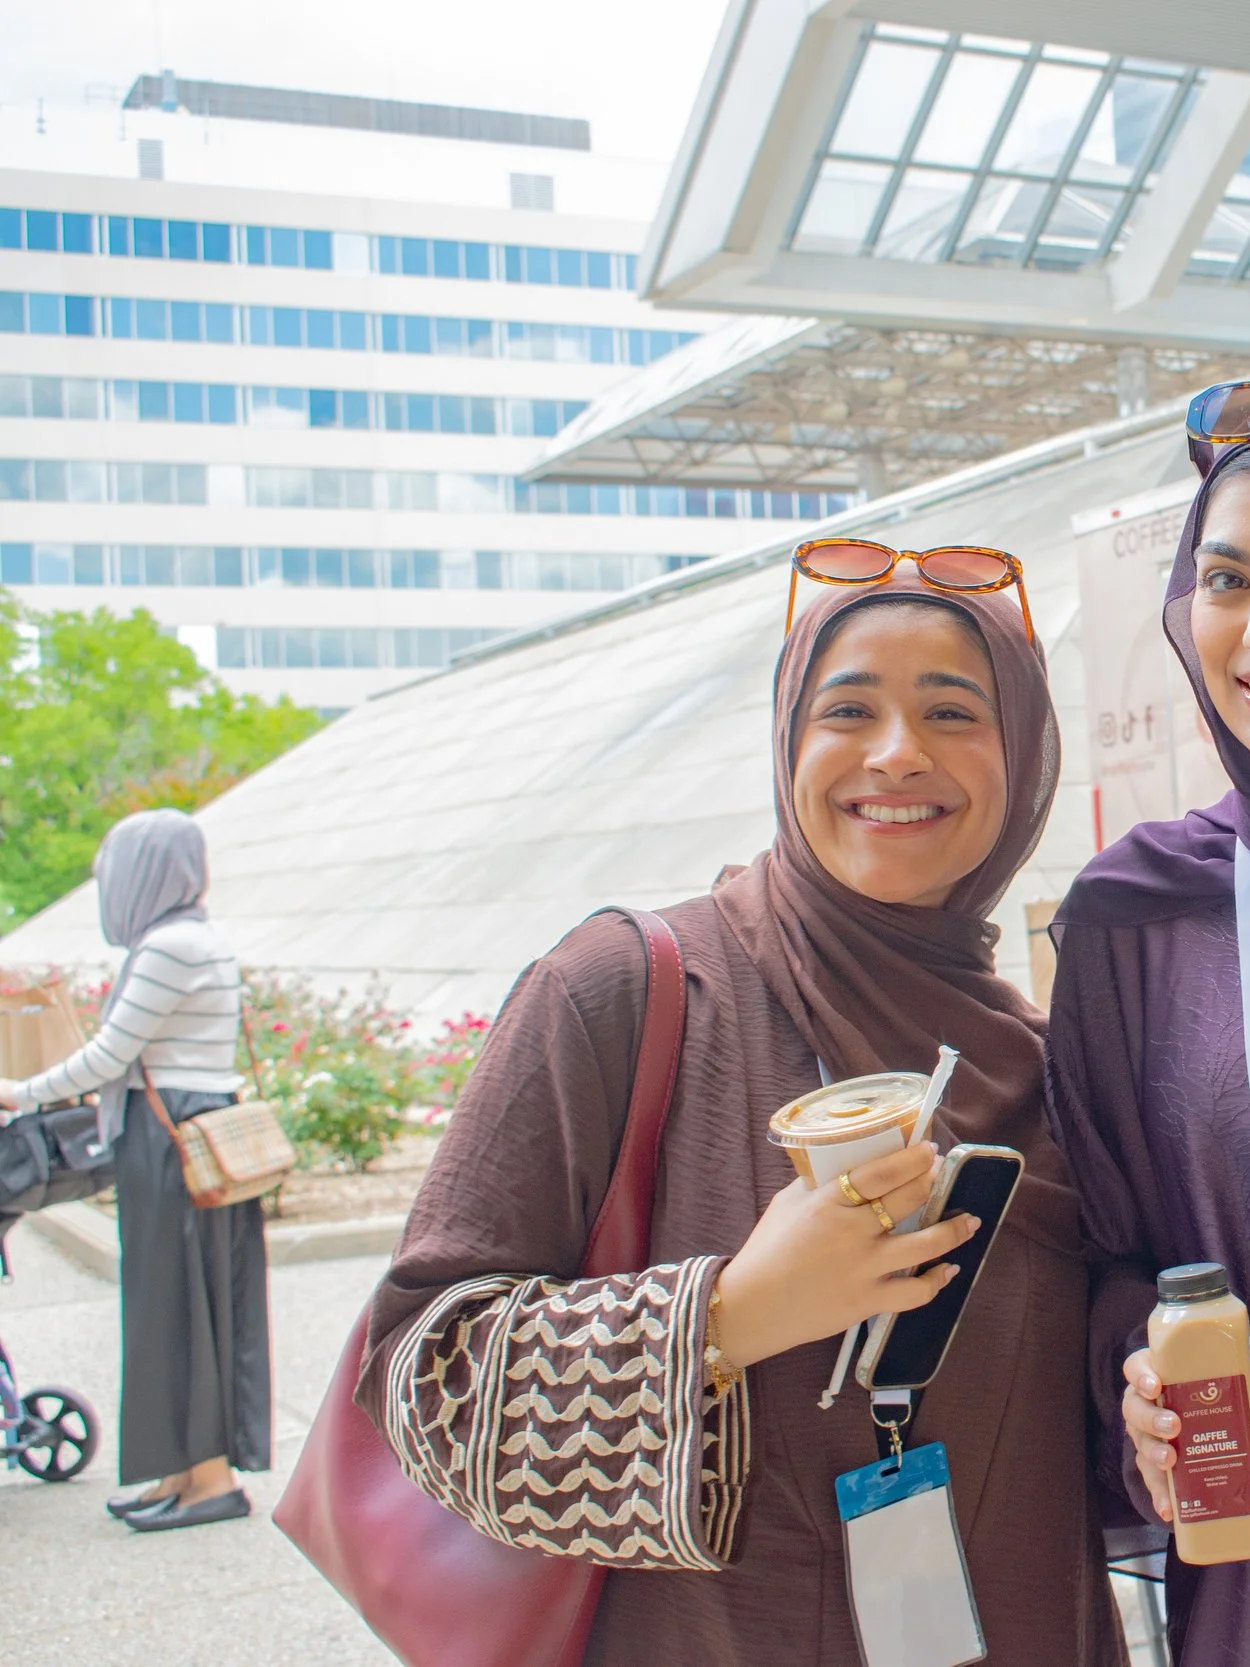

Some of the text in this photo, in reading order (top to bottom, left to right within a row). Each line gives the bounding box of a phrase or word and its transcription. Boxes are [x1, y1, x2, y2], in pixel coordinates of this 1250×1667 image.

[1183, 1405, 1233, 1418] QAFFEE HOUSE
[1192, 1430, 1228, 1443] QAFFEE
[1185, 1440, 1238, 1456] SIGNATURE
